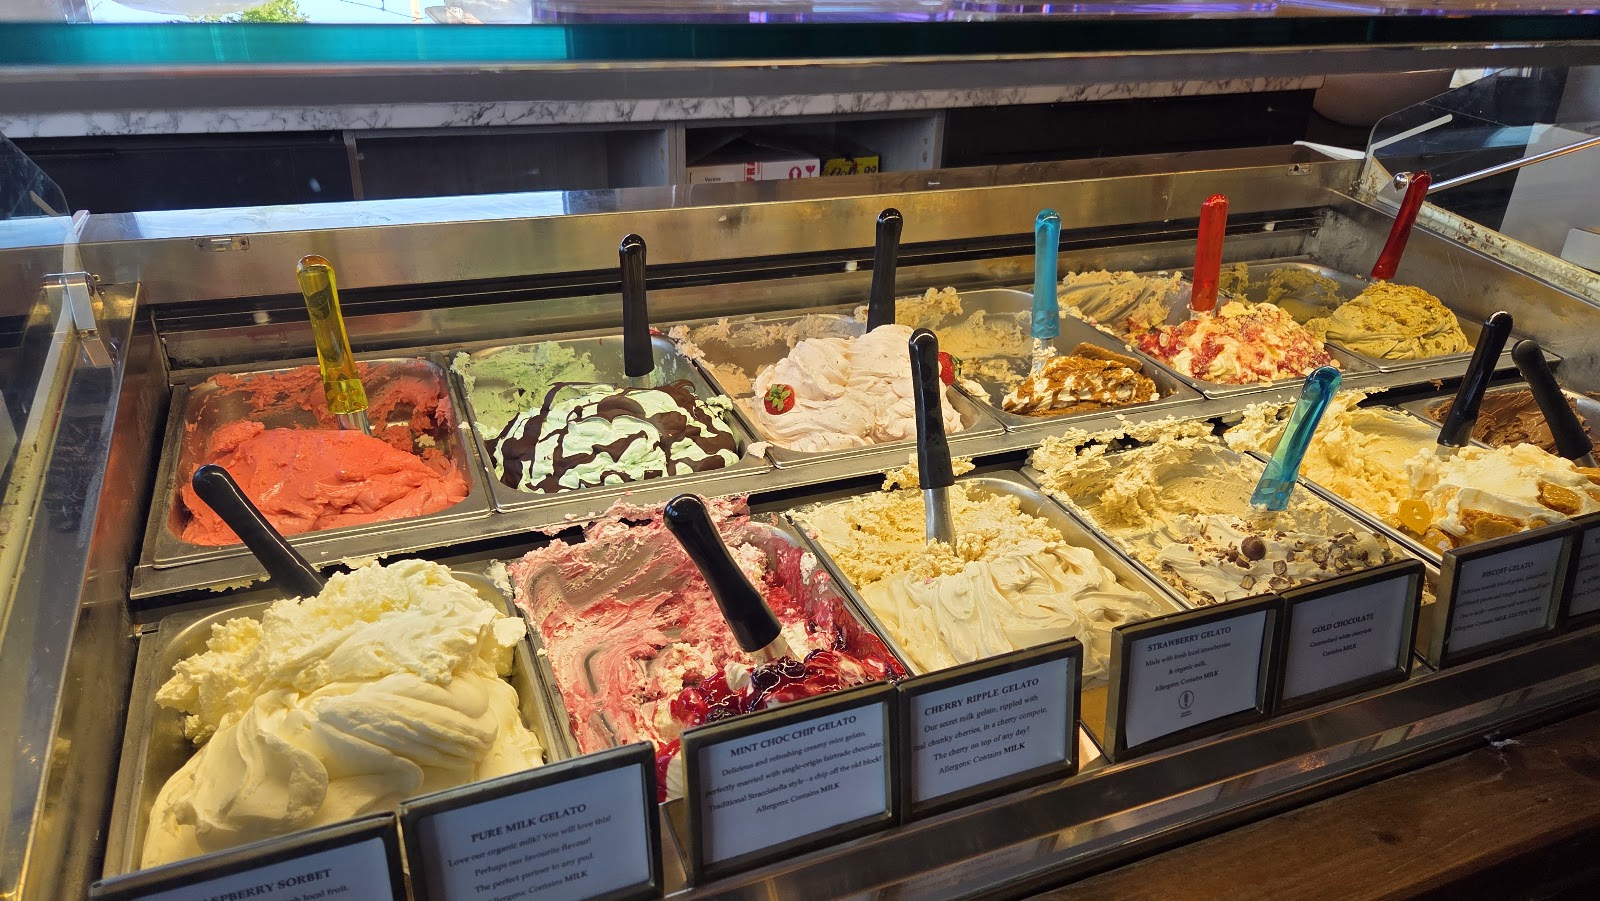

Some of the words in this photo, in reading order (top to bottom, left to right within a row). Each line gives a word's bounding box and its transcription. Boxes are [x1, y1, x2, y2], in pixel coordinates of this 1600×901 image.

[1482, 567, 1507, 579] BISCOFF
[1508, 562, 1534, 572] GELATO
[1147, 634, 1200, 652] STRAWBERRY
[1201, 627, 1232, 639] GELATO
[1312, 624, 1332, 634] GOLD
[1333, 612, 1375, 629] CHOCOLATE
[1145, 659, 1160, 667] Made
[1188, 649, 1199, 657] local
[1201, 641, 1231, 654] strawberries
[1343, 643, 1357, 651] MILK
[1174, 664, 1193, 673] organic
[1181, 676, 1202, 685] Contains
[1204, 670, 1219, 680] MILK
[924, 725, 938, 733] Our
[940, 718, 958, 729] secret
[960, 713, 975, 723] milk
[976, 708, 998, 720] gelato,
[1000, 698, 1022, 711] rippled
[1024, 694, 1039, 703] with
[925, 699, 964, 716] CHERRY
[967, 689, 999, 705] RIPPLE
[1002, 678, 1039, 694] GELATO
[730, 742, 758, 757] MINT
[760, 734, 790, 749] CHOC
[792, 726, 816, 739] CHIP
[817, 716, 857, 733] GELATO
[914, 742, 926, 752] real
[928, 734, 953, 747] chunky
[955, 726, 982, 739] cherries,
[997, 715, 1017, 726] cherry
[1019, 707, 1048, 720] compote.
[933, 753, 947, 761] The
[948, 745, 969, 756] cherry
[981, 738, 992, 747] top
[993, 734, 1002, 742] of
[1002, 732, 1014, 741] any
[1016, 726, 1030, 736] day!
[722, 762, 754, 776] Delicious
[755, 758, 768, 766] and
[769, 748, 803, 763] refreshing
[804, 741, 827, 753] creamy
[829, 736, 844, 745] mint
[845, 732, 866, 742] gelato,
[938, 760, 972, 775] Allergens:
[973, 751, 1002, 763] Contains
[1003, 742, 1026, 754] MILK
[706, 783, 735, 798] perfectly
[737, 775, 764, 787] married
[766, 770, 780, 779] with
[782, 758, 822, 775] single-origin
[824, 750, 851, 762] fairtrade
[709, 796, 747, 811] Traditional
[748, 784, 787, 800] Stracciatella
[789, 779, 804, 789] style
[815, 770, 828, 780] chip
[830, 767, 839, 775] off
[840, 764, 850, 772] the
[851, 761, 862, 769] old
[863, 755, 882, 766] block!
[756, 799, 790, 813] Allergens:
[791, 790, 819, 803] Contains
[820, 782, 840, 793] MILK
[471, 826, 502, 843] PURE
[505, 817, 537, 833] MILK
[539, 804, 587, 824] GELATO
[448, 856, 469, 867] Love
[472, 853, 485, 861] our
[488, 842, 517, 857] organic
[519, 835, 541, 847] milk?
[542, 831, 559, 841] You
[561, 825, 576, 835] will
[577, 821, 594, 831] love
[595, 815, 612, 826] this!
[475, 863, 508, 877] Perhaps
[524, 848, 560, 862] favourite
[562, 837, 592, 851] flavour!
[277, 868, 332, 889] SORBET
[303, 889, 325, 901] local
[327, 885, 348, 897] fruit.
[475, 884, 491, 893] The
[493, 875, 519, 890] perfect
[522, 867, 550, 882] partner
[561, 860, 575, 870] any
[529, 879, 563, 894] Contains
[565, 870, 588, 883] MILK
